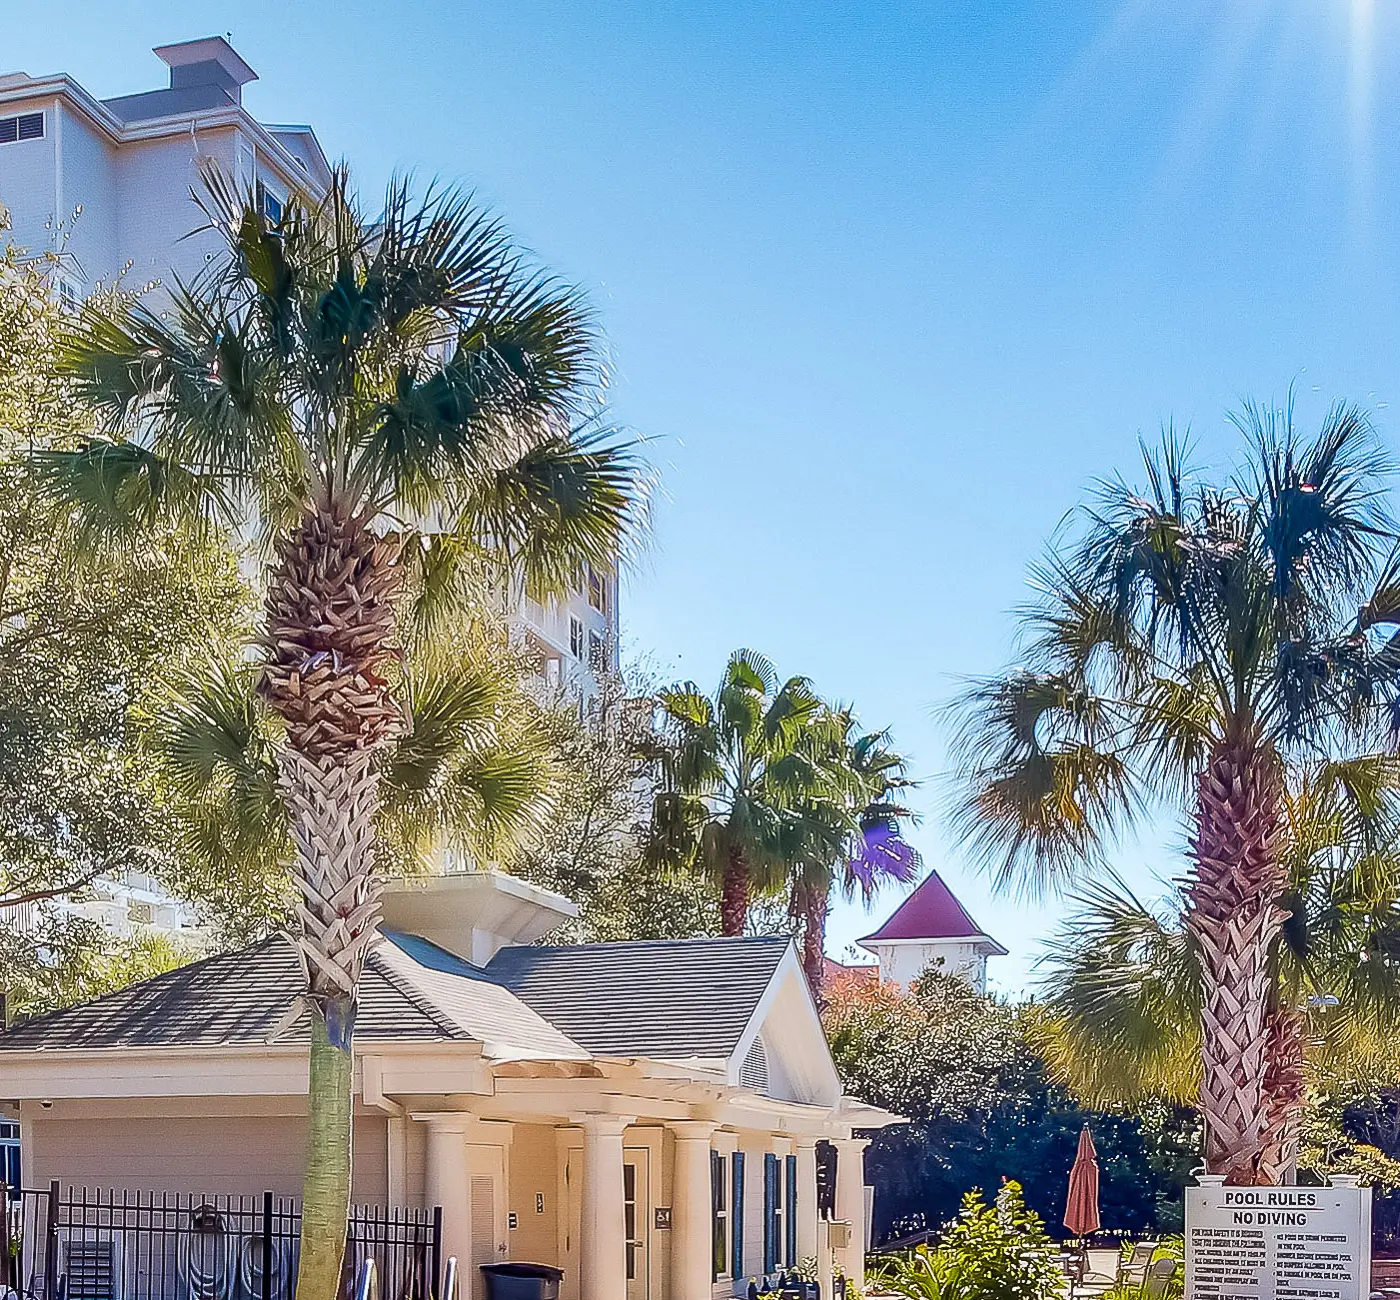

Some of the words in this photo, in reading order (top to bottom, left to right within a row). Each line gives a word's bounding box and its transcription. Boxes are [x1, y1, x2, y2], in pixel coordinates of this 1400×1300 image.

[1225, 1192, 1263, 1206] POOL
[1267, 1193, 1316, 1206] RULES
[1233, 1212, 1253, 1224] NO
[1257, 1213, 1307, 1226] DIVING
